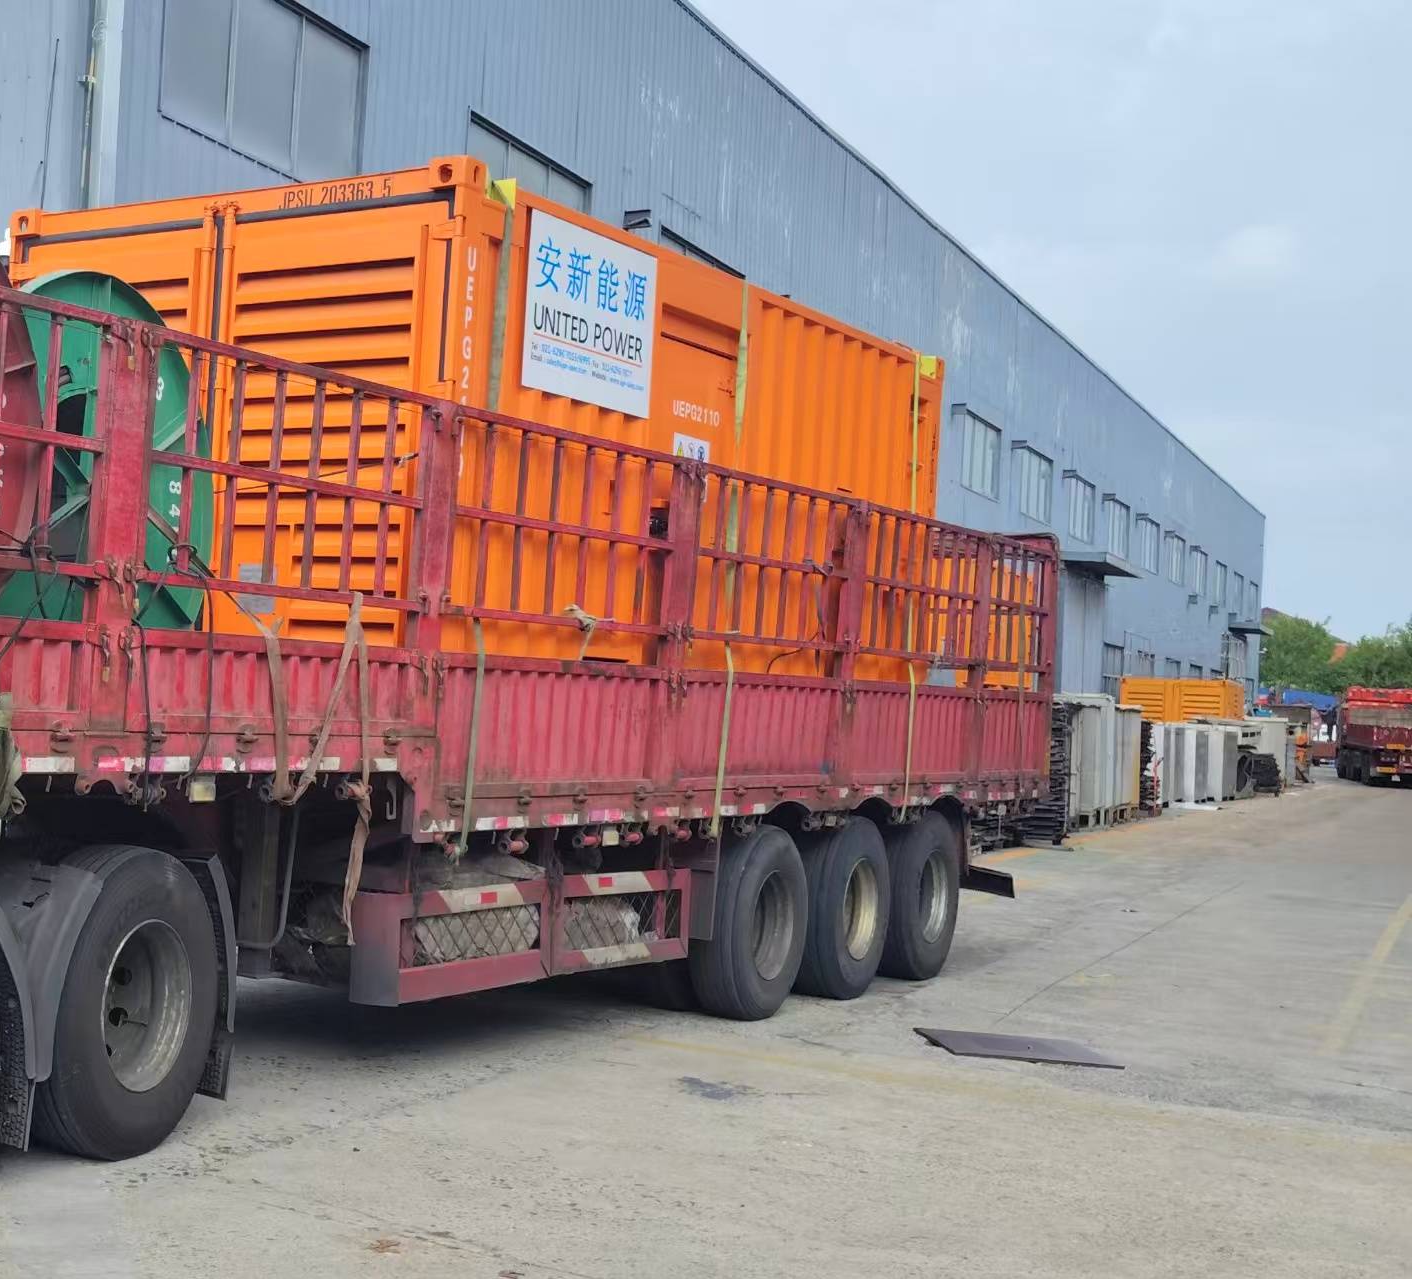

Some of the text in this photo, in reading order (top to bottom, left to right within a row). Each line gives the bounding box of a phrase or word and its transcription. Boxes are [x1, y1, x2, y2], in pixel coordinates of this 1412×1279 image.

[535, 236, 647, 320] 安新能源
[533, 302, 588, 344] UNITED
[593, 322, 643, 363] POWER
[673, 399, 720, 427] UEPG2110
